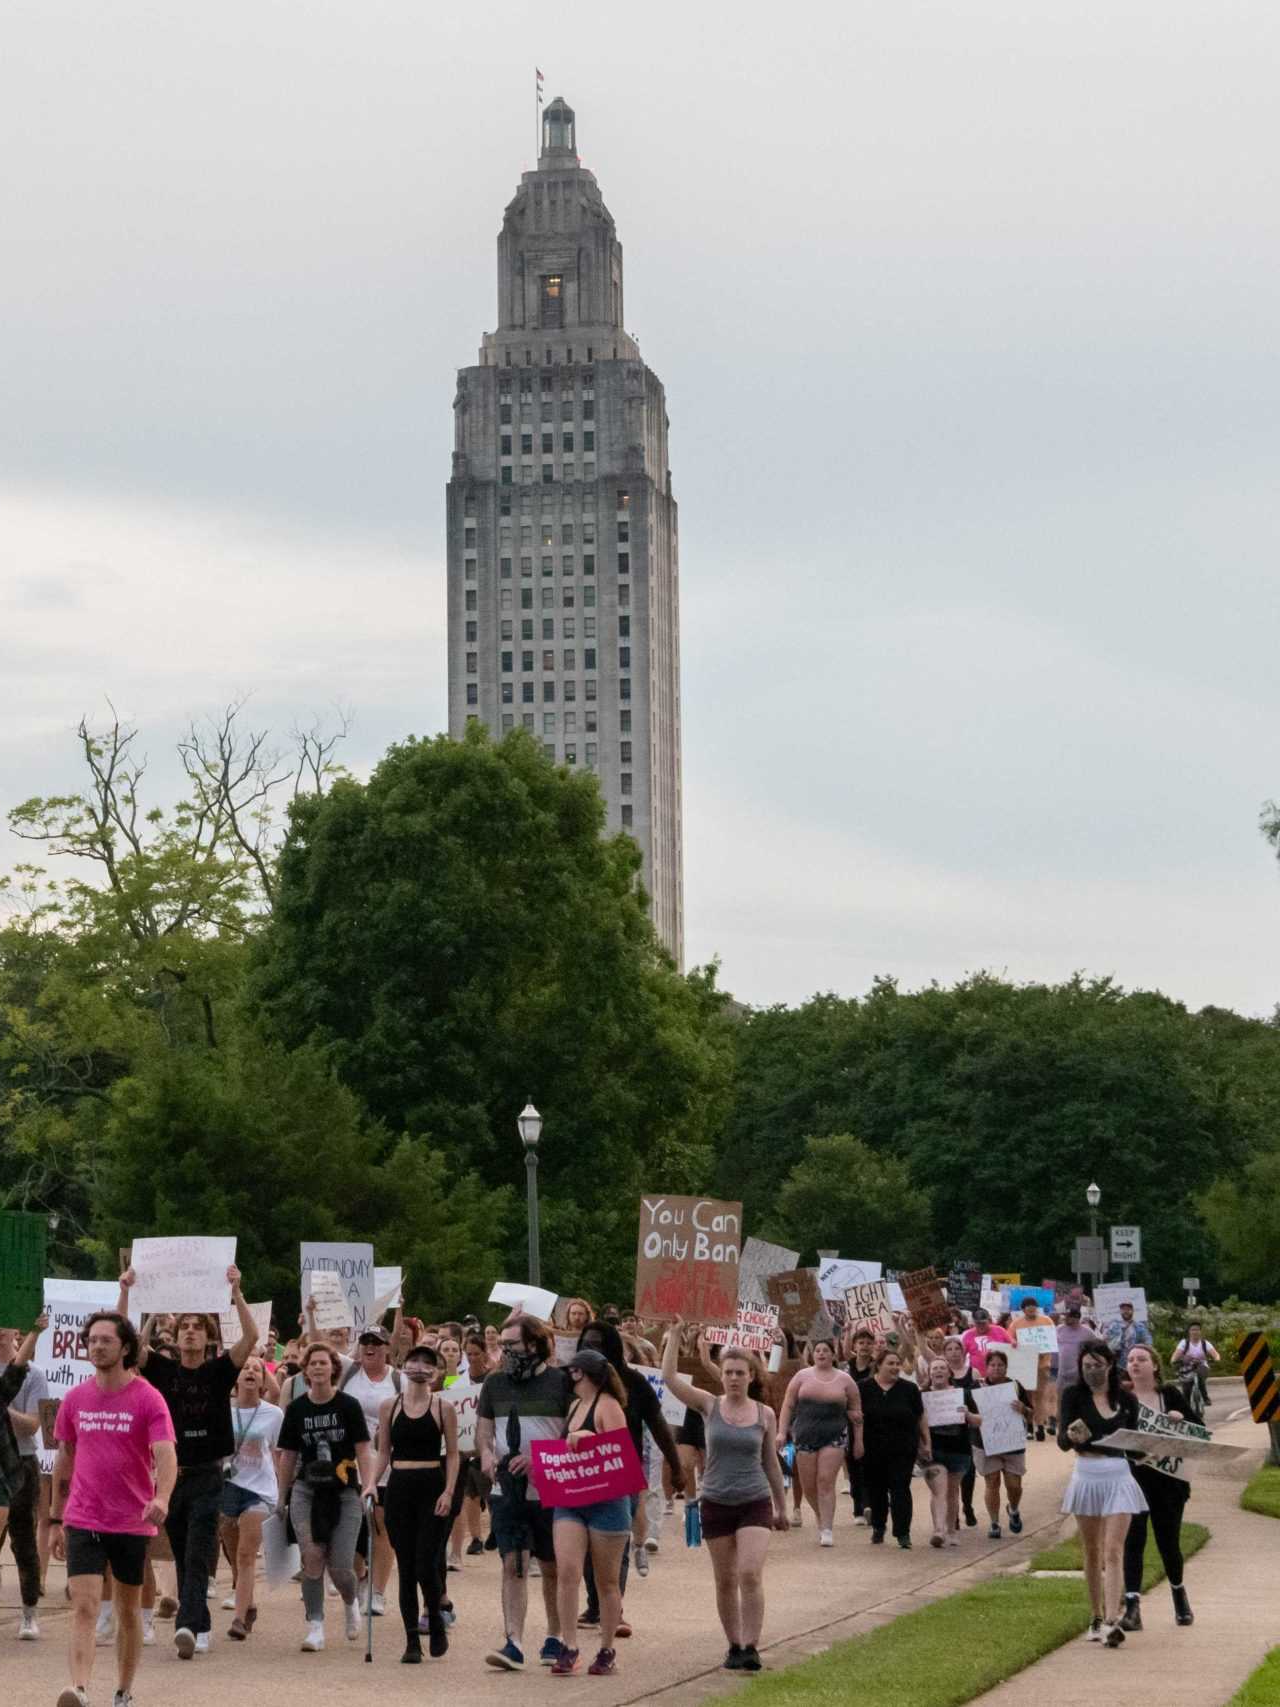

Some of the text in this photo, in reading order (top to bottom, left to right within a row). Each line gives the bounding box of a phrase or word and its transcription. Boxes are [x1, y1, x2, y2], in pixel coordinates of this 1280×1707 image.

[642, 1199, 739, 1234] You Can
[1115, 1229, 1135, 1237] KEEP
[643, 1231, 738, 1264] Only Ban
[1114, 1252, 1136, 1260] RIGHT
[302, 1255, 372, 1279] AUTONOMY
[843, 1280, 886, 1307] FIGHT
[54, 1312, 75, 1330] you
[847, 1304, 878, 1321] LIKE
[878, 1301, 889, 1314] A
[52, 1329, 91, 1361] BRE
[731, 1331, 740, 1346] A
[45, 1365, 74, 1387] with
[78, 1409, 134, 1421] Together We
[79, 1421, 131, 1432] Fight for All
[539, 1442, 622, 1467] Together We
[543, 1456, 625, 1484] Fight for All
